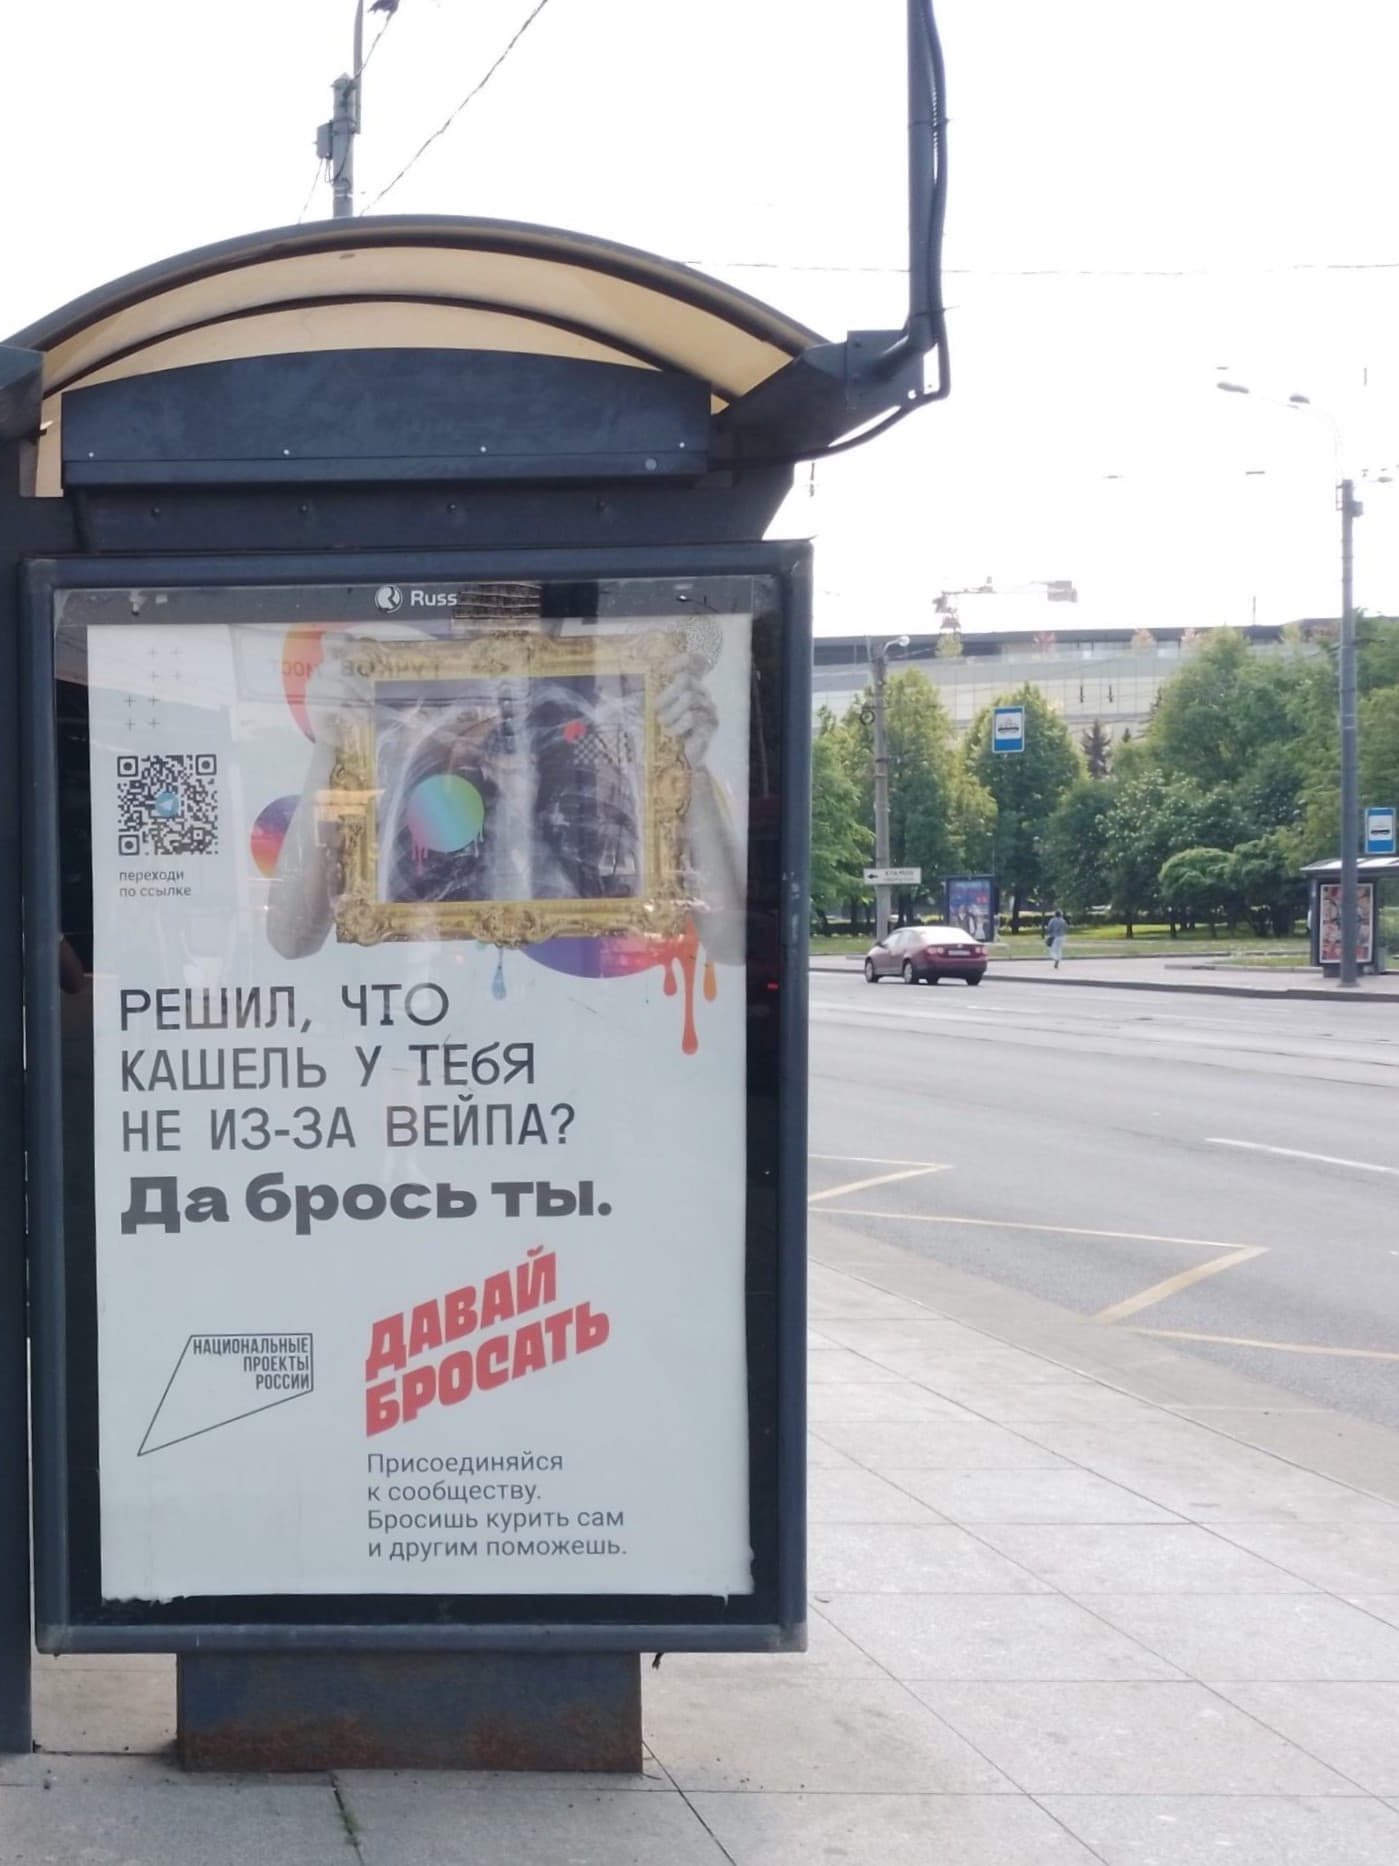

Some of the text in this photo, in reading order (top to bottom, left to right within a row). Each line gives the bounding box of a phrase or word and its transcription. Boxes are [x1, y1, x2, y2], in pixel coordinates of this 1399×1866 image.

[410, 590, 458, 606] Russ
[119, 870, 185, 884] переходи
[119, 886, 192, 898] по ссылке
[120, 982, 450, 1033] РЕШИЛ, ЧТО
[121, 1046, 327, 1092] КАШЕЛЬ
[354, 1044, 383, 1088] У
[122, 1093, 576, 1153] НЕ ИЗ-ЗА ВЕЙПА?
[120, 1171, 613, 1236] Да брось ты.
[365, 1244, 557, 1382] ДАВАЙ
[193, 1337, 309, 1357] НАЦИОНАЛЬНЫЕ
[243, 1355, 309, 1373] ПРОЕКТЫ
[365, 1301, 611, 1438] БРОСАТЬ
[255, 1373, 309, 1391] РОССИИ
[367, 1450, 563, 1477] Присоединяйся
[367, 1479, 541, 1505] к сообществу.
[367, 1509, 624, 1534] Бросишь курить сам
[368, 1539, 627, 1563] и другим поможешь.
